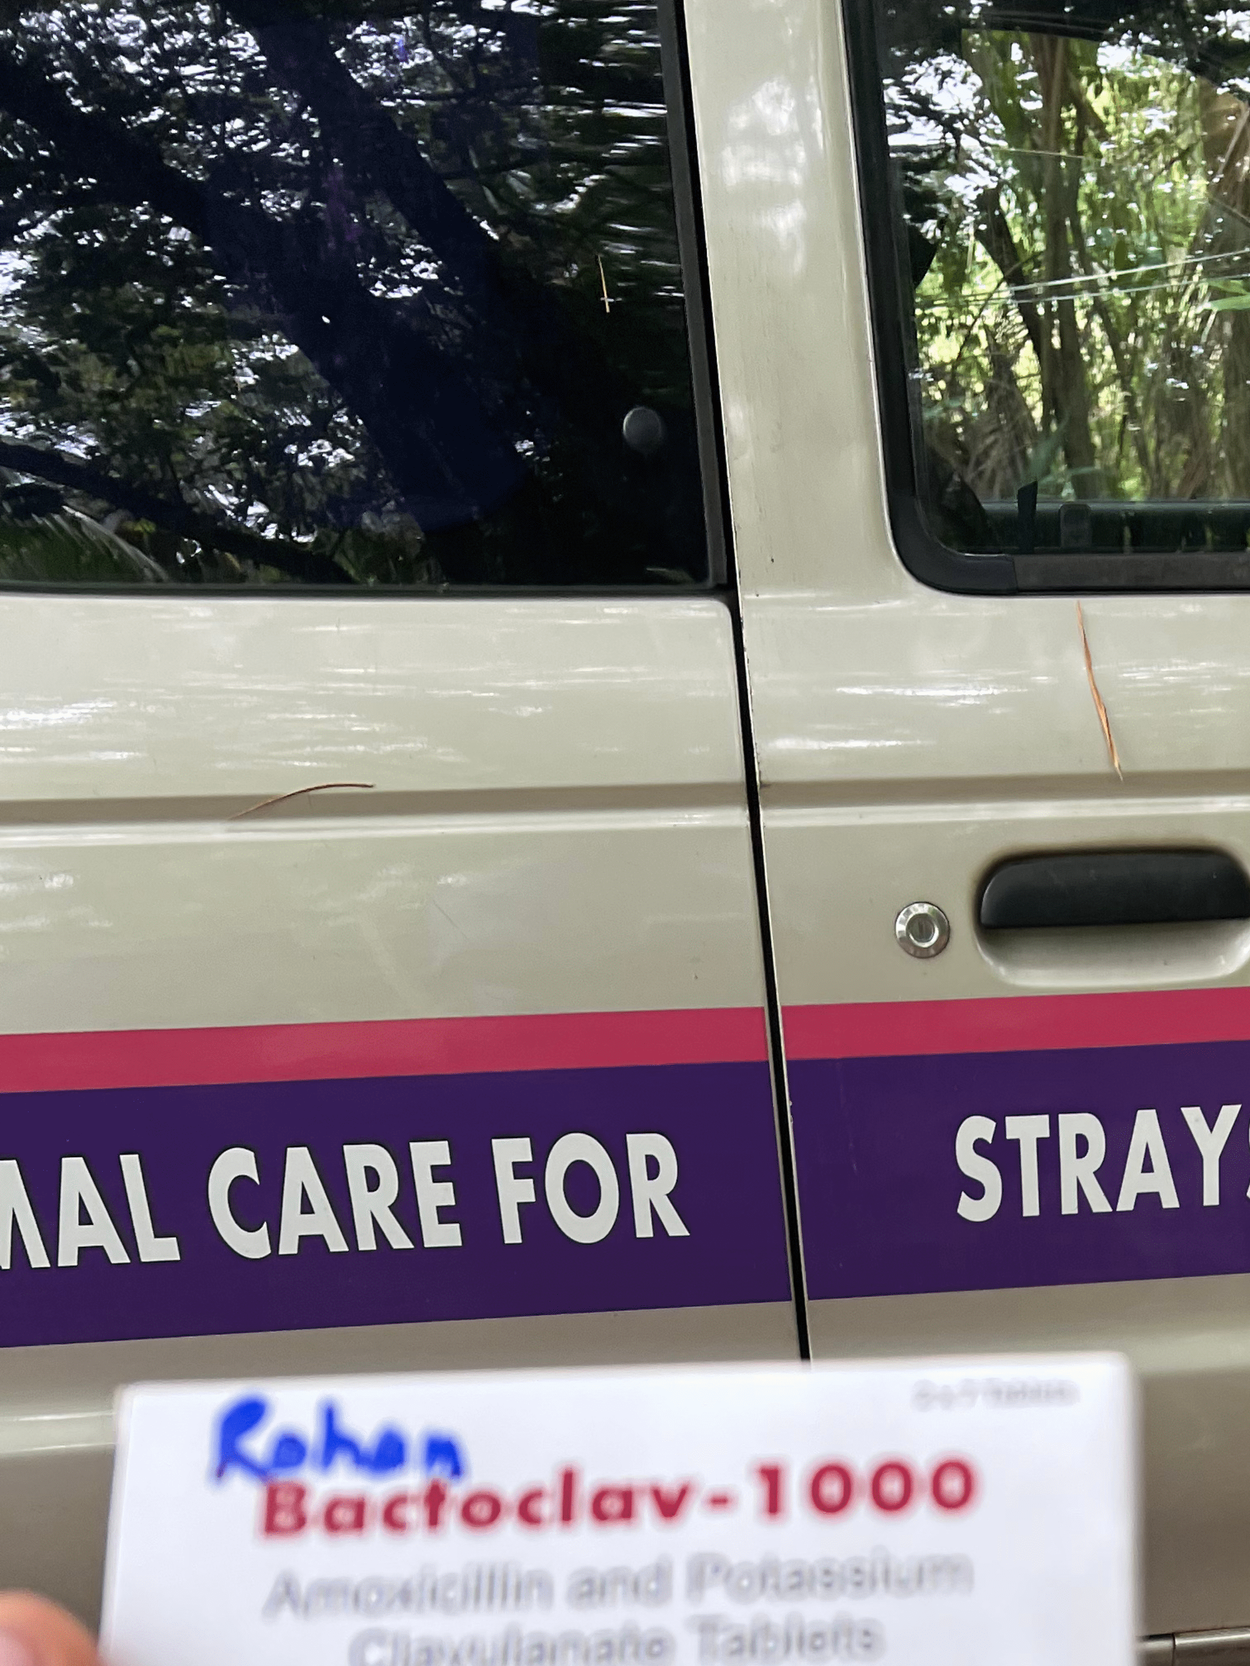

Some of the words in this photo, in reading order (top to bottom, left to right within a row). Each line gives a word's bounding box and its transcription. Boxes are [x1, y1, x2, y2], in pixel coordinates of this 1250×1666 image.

[208, 1140, 463, 1259] CARE
[491, 1132, 690, 1244] FOR
[257, 1456, 984, 1538] Bactoclav-1000
[262, 1560, 556, 1620] Amoxicillin
[562, 1553, 675, 1610] and
[686, 1546, 976, 1603] Potassium
